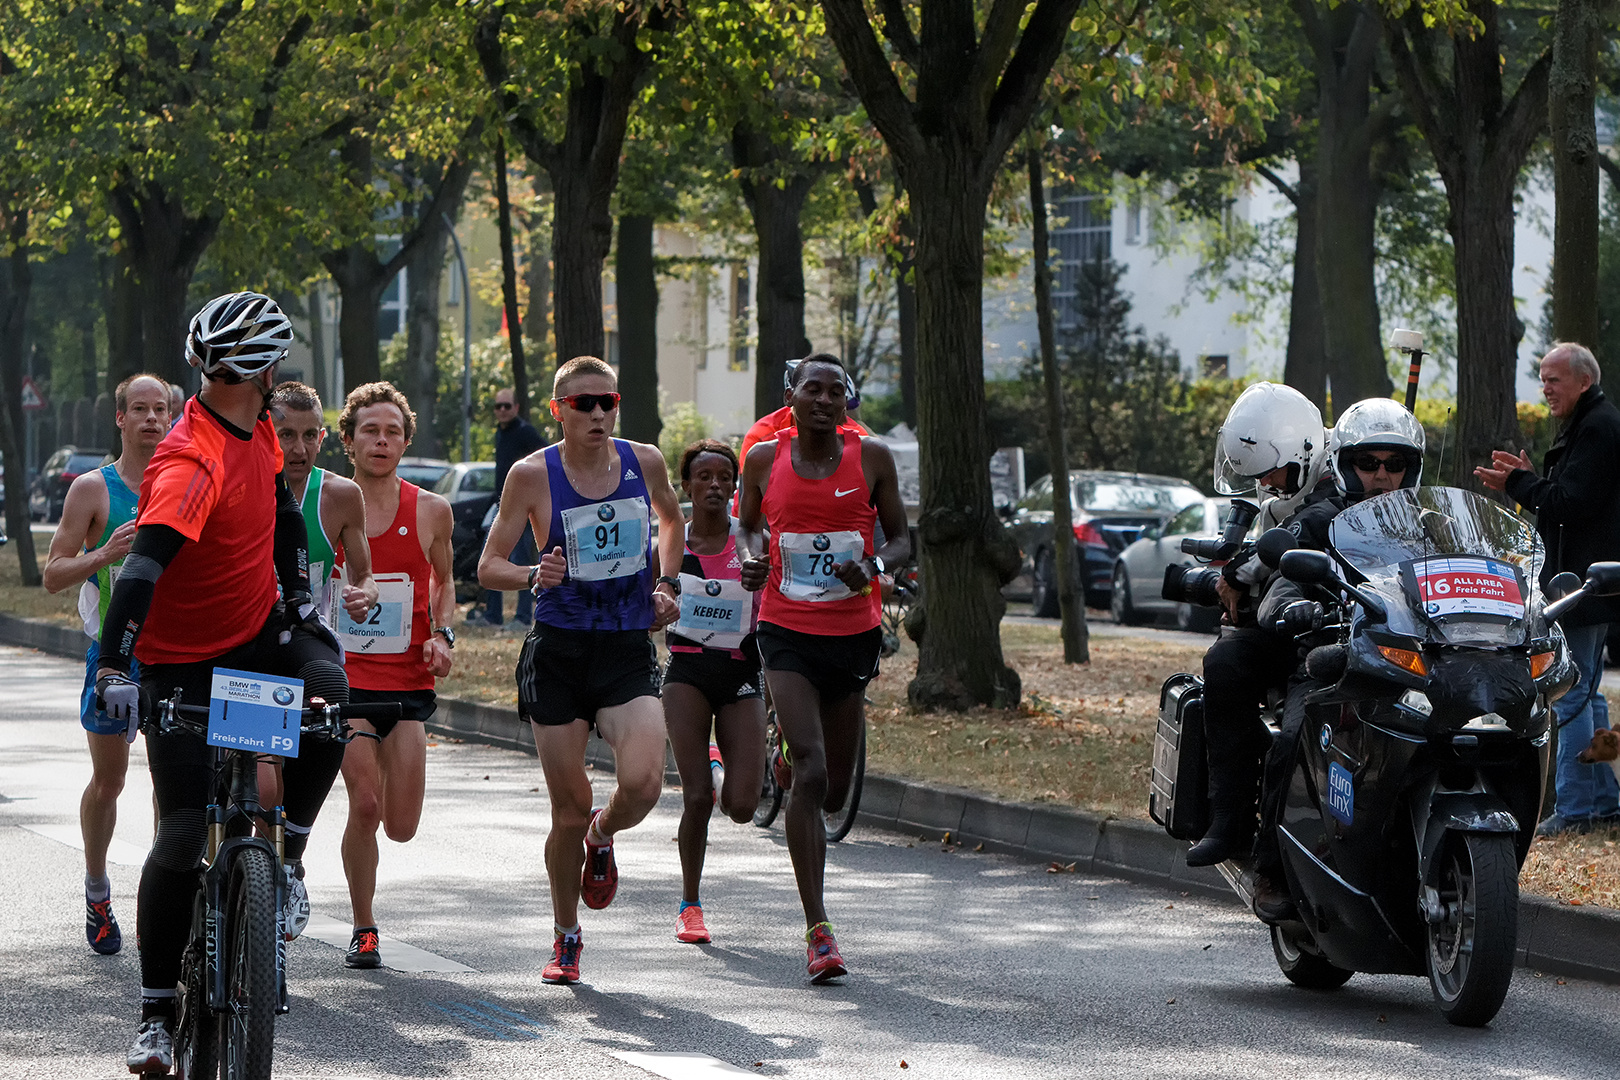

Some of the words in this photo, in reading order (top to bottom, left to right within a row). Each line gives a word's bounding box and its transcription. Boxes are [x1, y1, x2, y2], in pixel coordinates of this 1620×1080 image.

[595, 522, 620, 550] 91
[594, 550, 626, 562] Vladimir
[808, 554, 834, 576] 78
[1420, 578, 1451, 596] 16
[1454, 578, 1474, 586] ALL
[1476, 578, 1504, 588] AREA
[1455, 586, 1478, 594] Freie
[1480, 586, 1504, 597] Fahrt
[368, 603, 382, 625] 2
[693, 605, 733, 620] KEBEDE
[348, 626, 386, 637] Geronimo
[229, 680, 250, 689] BMW
[228, 690, 261, 700] MARATHON
[212, 732, 237, 744] Freie
[238, 736, 265, 748] Fahrt
[271, 735, 294, 751] F9
[1330, 766, 1352, 797] Euro
[1329, 786, 1350, 817] LinX
